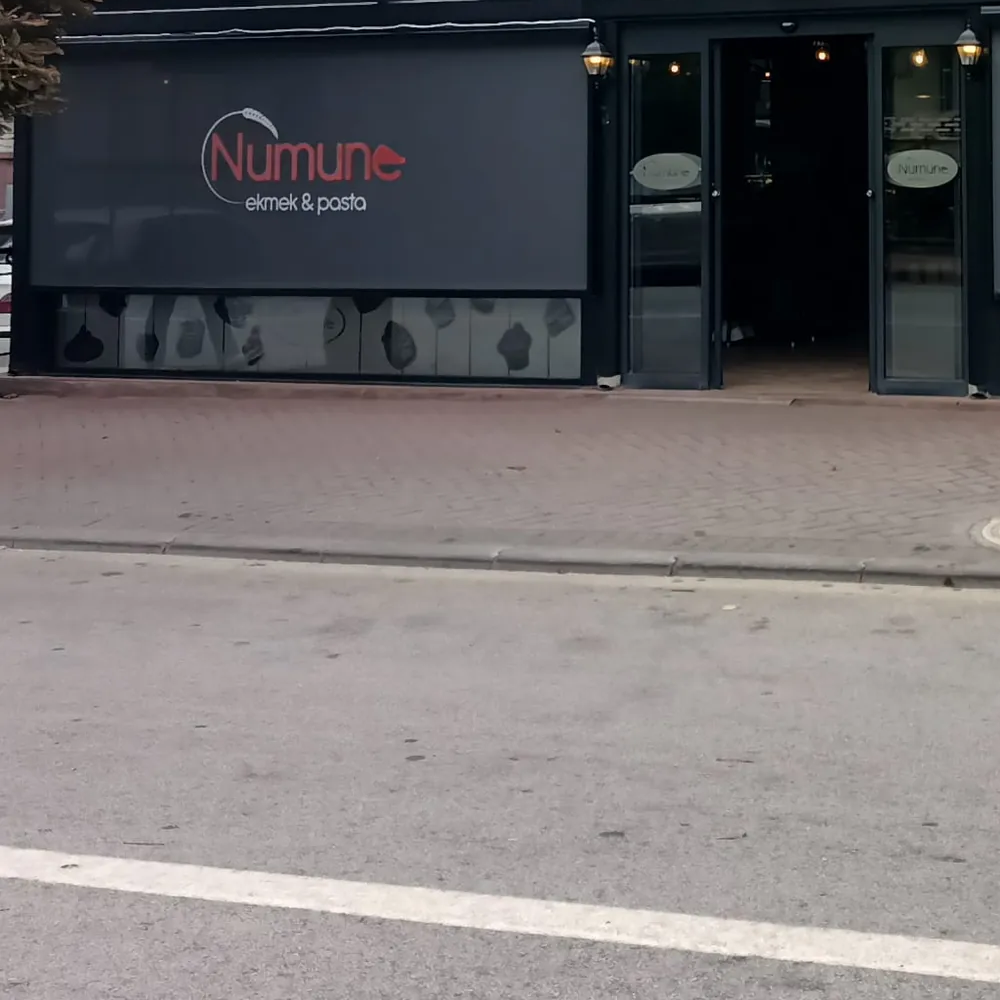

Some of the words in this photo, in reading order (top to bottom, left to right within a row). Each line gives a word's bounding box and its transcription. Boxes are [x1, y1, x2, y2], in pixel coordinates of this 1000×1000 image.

[211, 131, 406, 182] Numune
[245, 192, 299, 212] ekmek
[301, 192, 315, 212] &
[316, 192, 367, 216] pasta
